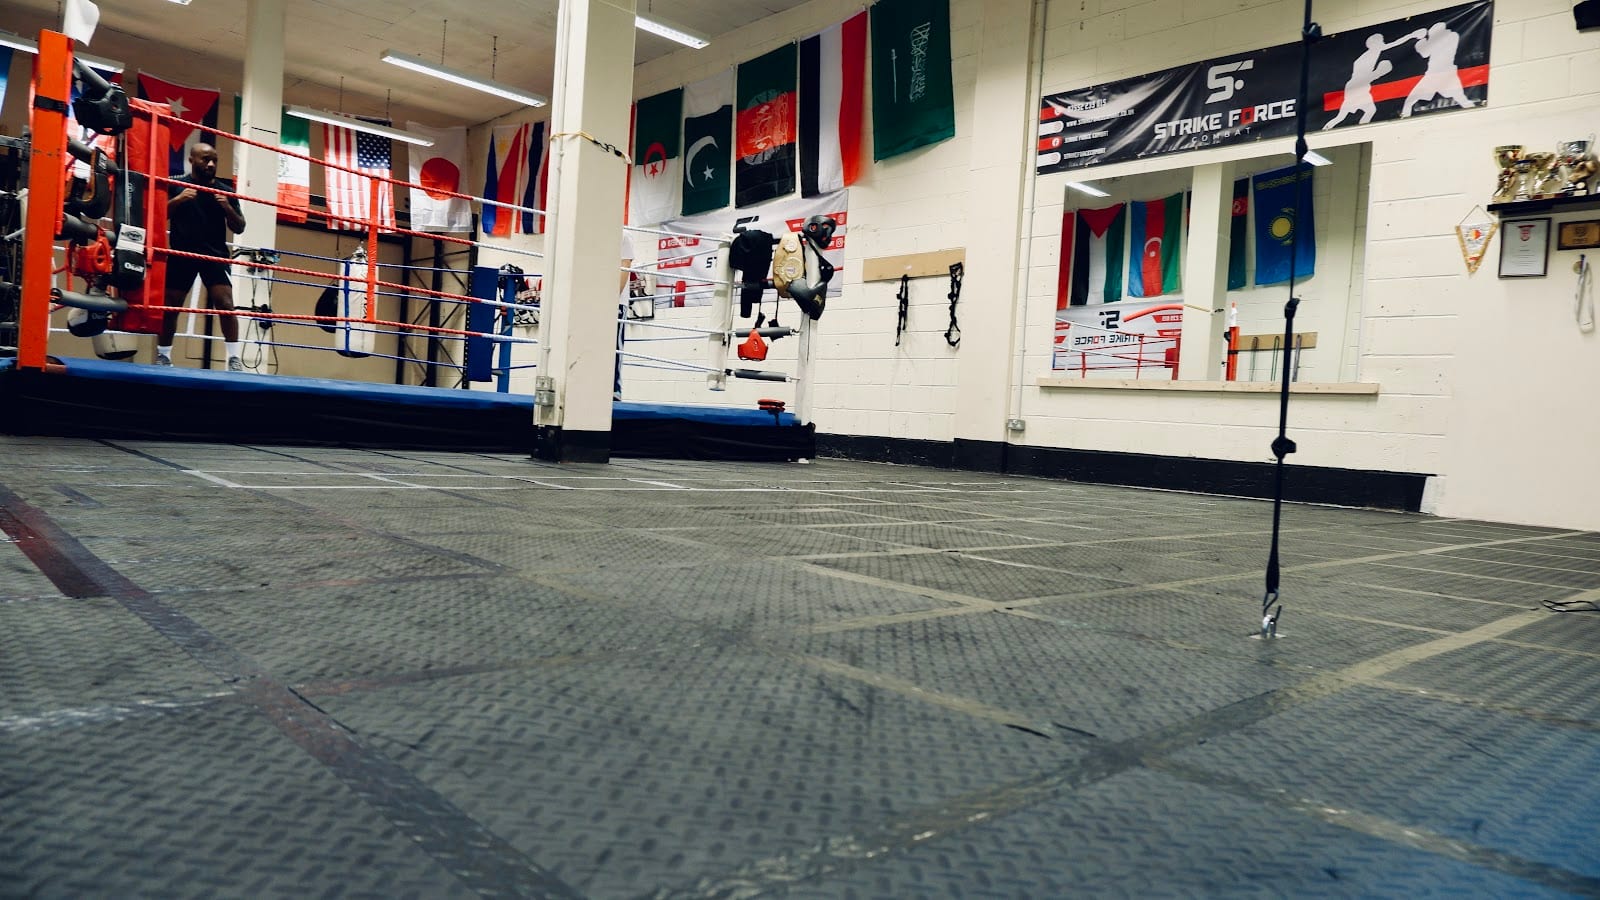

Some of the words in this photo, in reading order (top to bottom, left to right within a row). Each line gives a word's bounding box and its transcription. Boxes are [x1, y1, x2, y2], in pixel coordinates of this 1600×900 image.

[1154, 112, 1222, 140] STRIKE
[1228, 98, 1297, 127] FORCE
[1191, 127, 1251, 144] COMBAT
